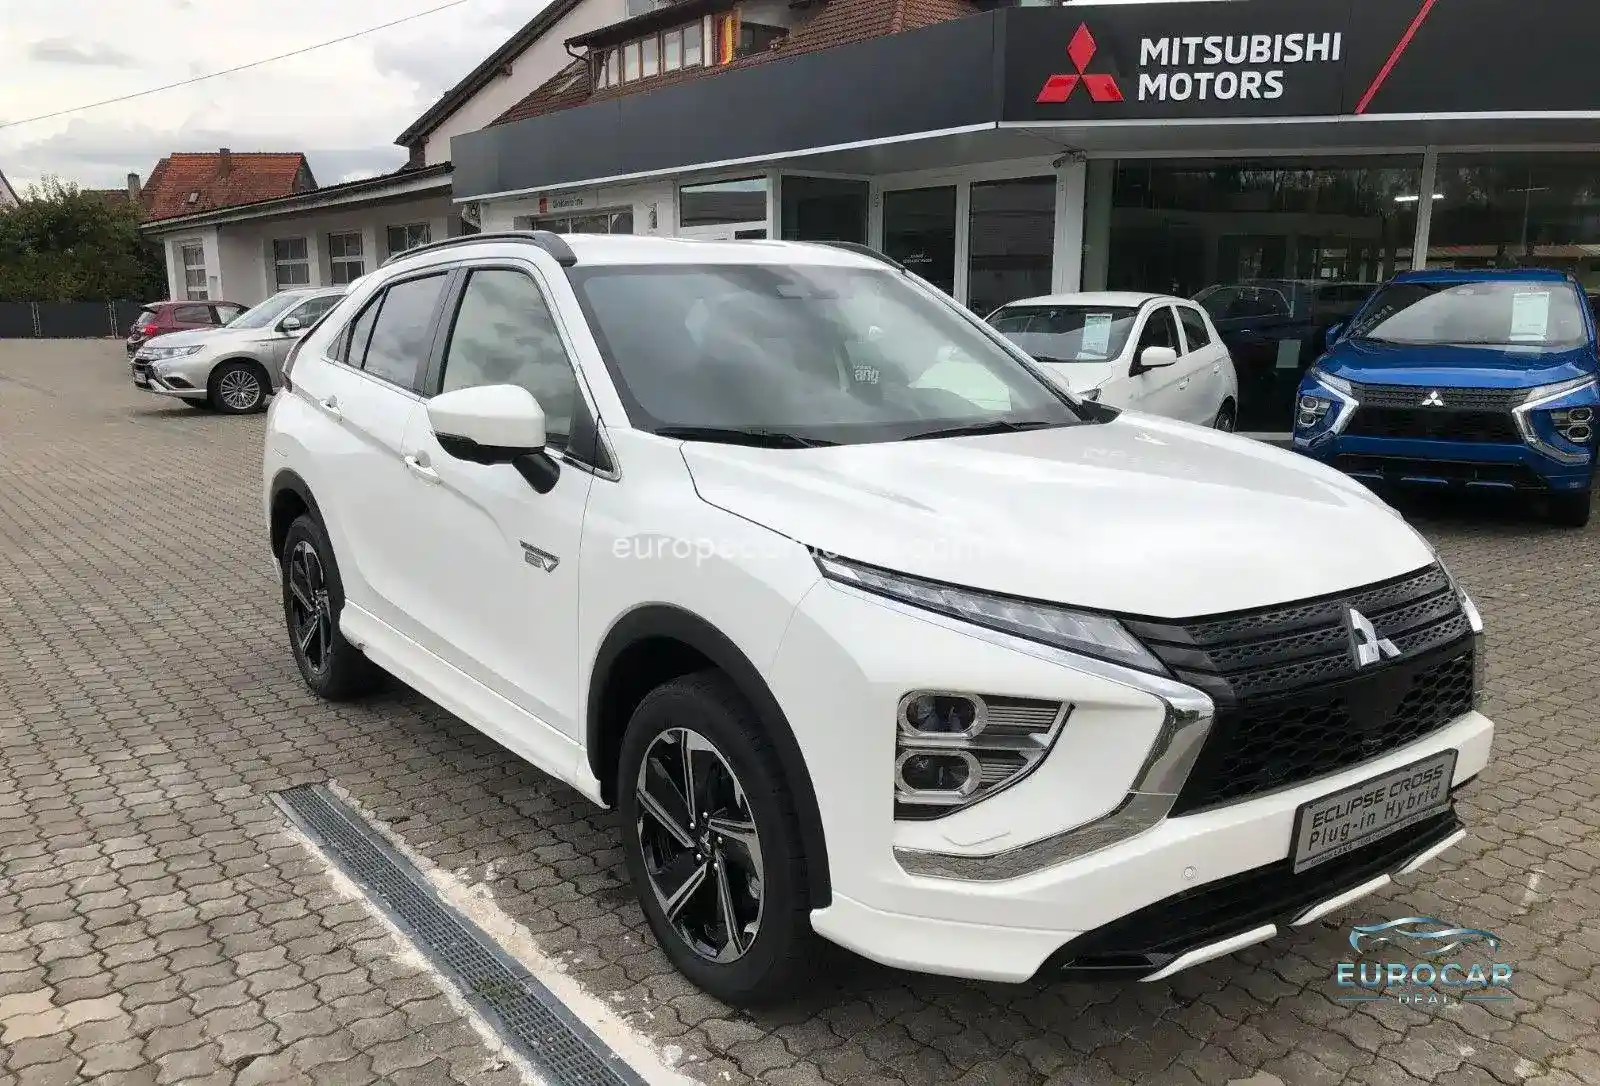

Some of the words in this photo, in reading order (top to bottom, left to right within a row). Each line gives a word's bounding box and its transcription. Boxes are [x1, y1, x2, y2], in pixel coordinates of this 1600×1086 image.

[1138, 31, 1342, 67] MITSUBISHI
[1137, 69, 1285, 102] MOTORS
[1308, 812, 1377, 852] Plug-in
[1384, 780, 1441, 822] Hybrid
[1312, 785, 1386, 830] ECLIPSE
[1388, 763, 1445, 799] CROSS
